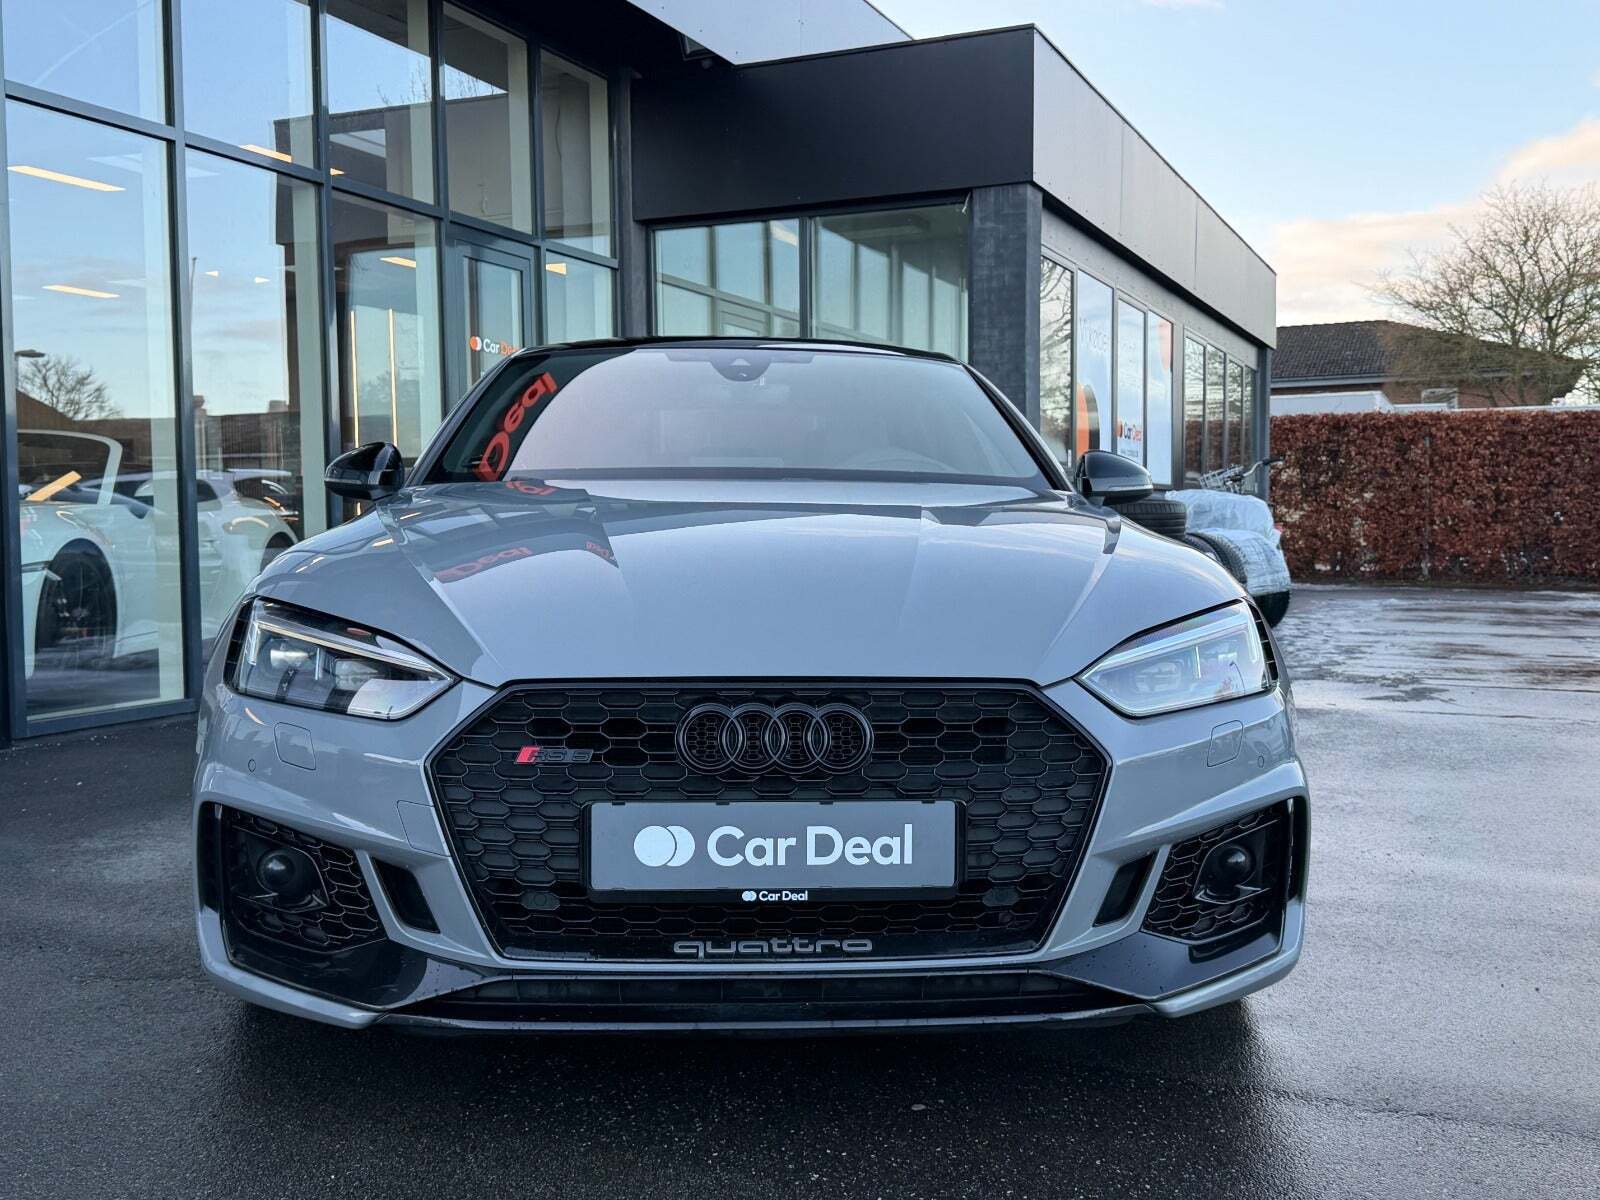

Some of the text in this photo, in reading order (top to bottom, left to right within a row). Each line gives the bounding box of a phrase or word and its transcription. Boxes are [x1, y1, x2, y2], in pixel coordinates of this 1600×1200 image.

[483, 338, 500, 354] Car
[707, 823, 913, 867] Car Deal
[759, 889, 808, 902] Car Deal
[673, 936, 873, 959] quattro
